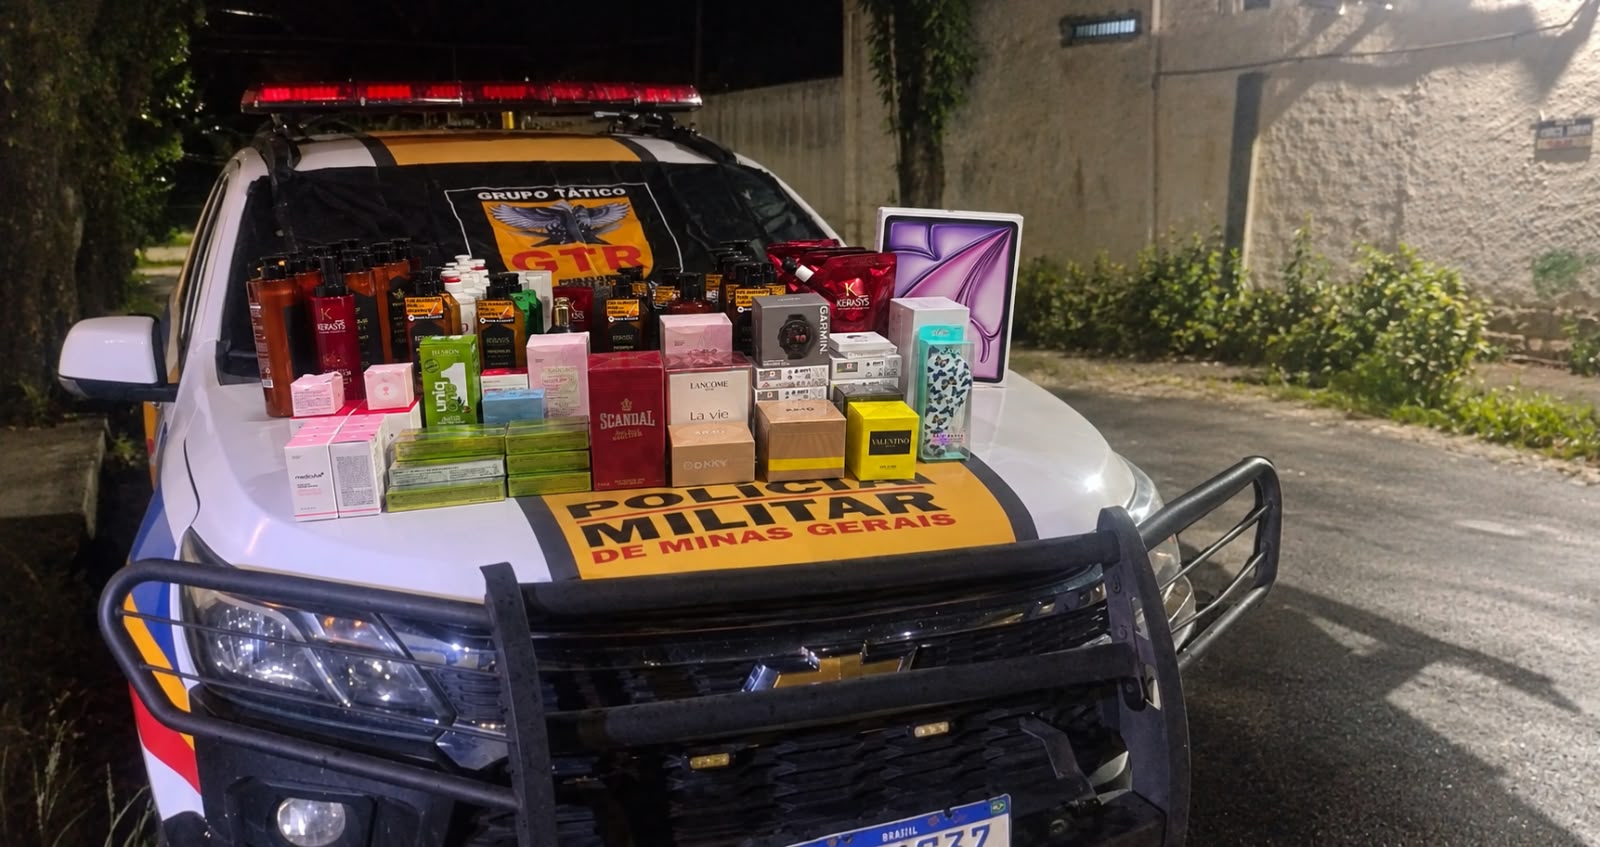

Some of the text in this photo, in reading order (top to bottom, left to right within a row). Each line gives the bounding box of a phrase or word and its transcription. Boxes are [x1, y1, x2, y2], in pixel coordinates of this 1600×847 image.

[478, 187, 625, 200] GRUPO TÁTICO
[512, 245, 643, 273] GTR
[836, 294, 870, 307] KERASYS
[317, 319, 346, 331] KERASYS
[820, 305, 829, 352] GARMIN
[600, 410, 656, 430] SCANDAL
[690, 409, 729, 421] La vie
[872, 437, 910, 446] VALENTINO
[580, 491, 947, 548] MILITAR
[591, 513, 957, 565] DE MINAS GERAIS
